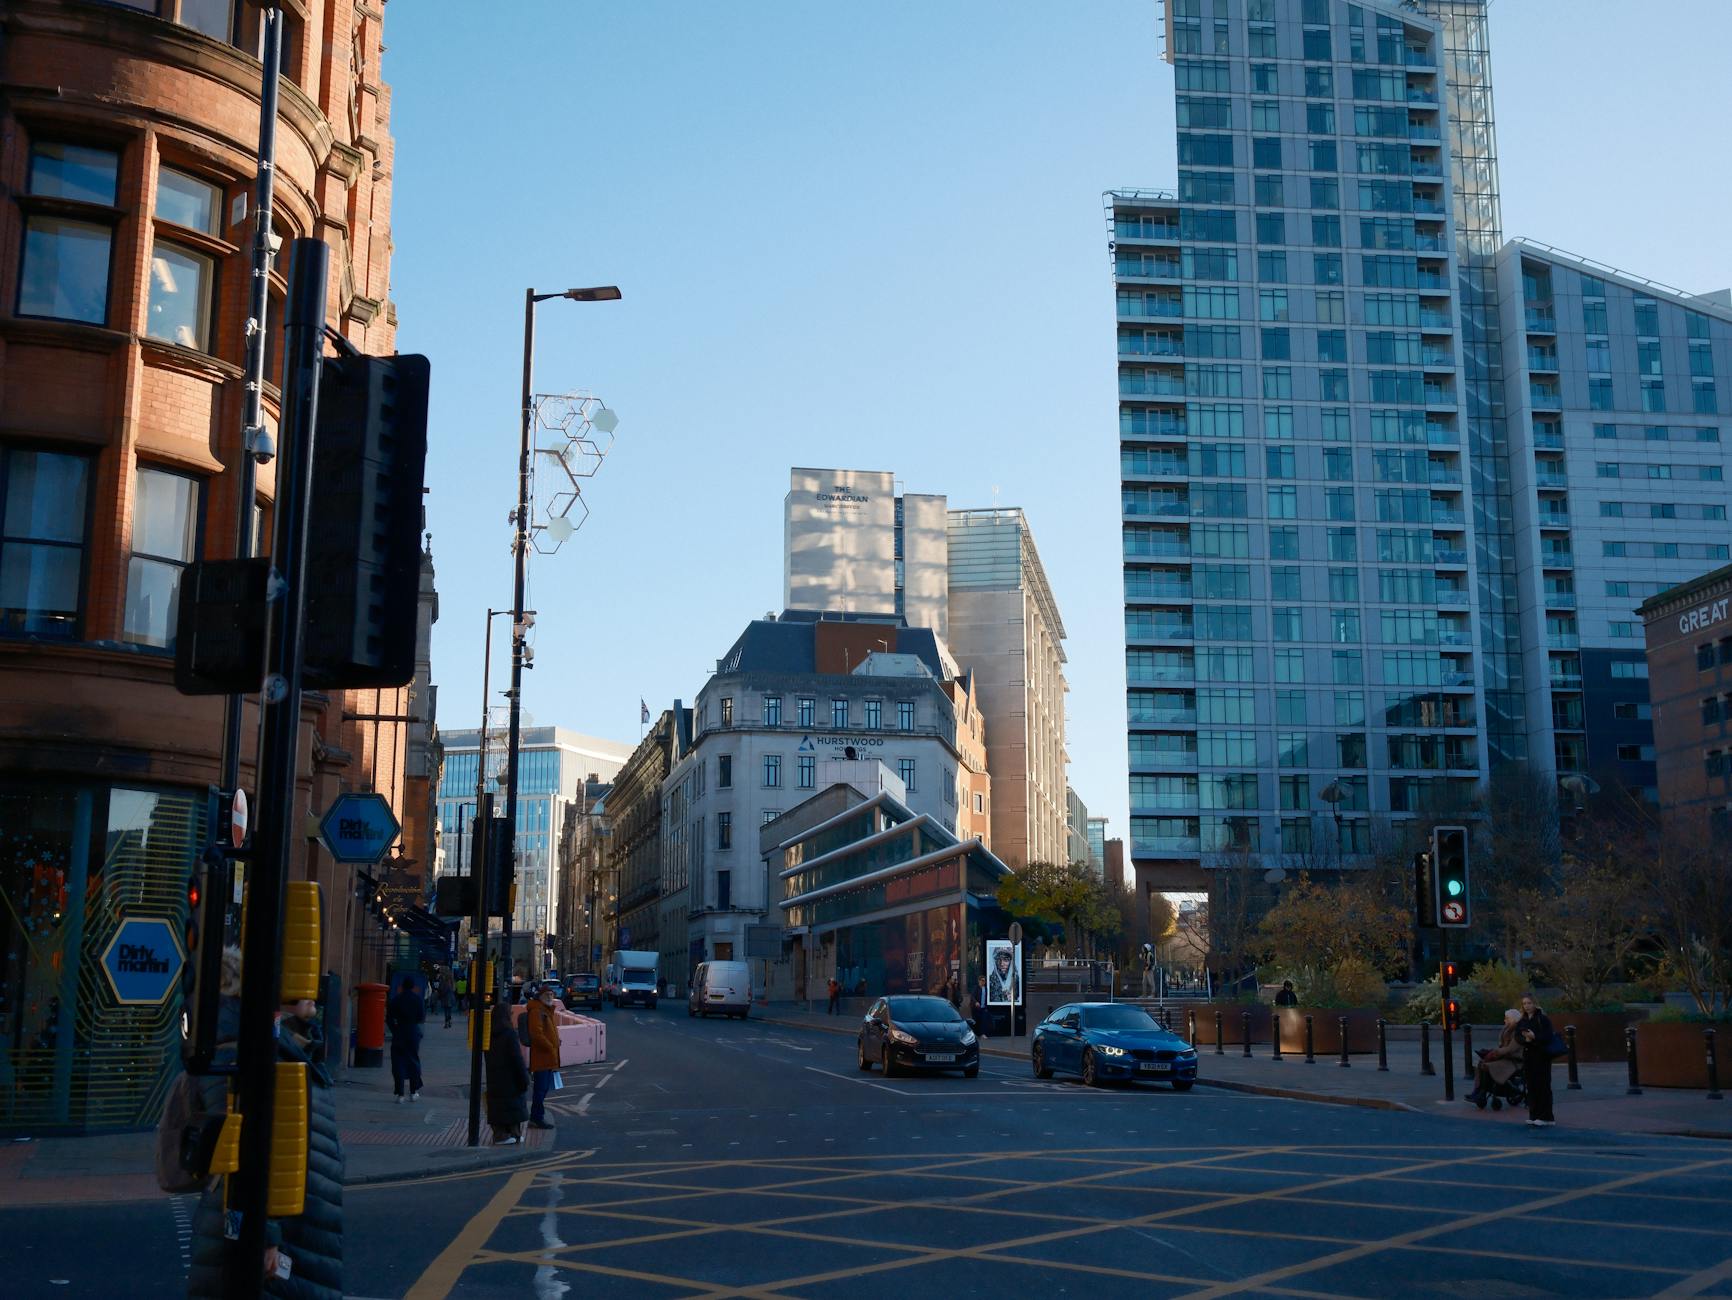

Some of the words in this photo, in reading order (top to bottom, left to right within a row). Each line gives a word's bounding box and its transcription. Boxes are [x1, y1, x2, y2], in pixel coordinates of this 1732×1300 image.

[816, 494, 869, 502] EDWARDIAN
[1679, 599, 1729, 634] GREAT
[817, 737, 884, 746] HURSTWOOD
[339, 818, 369, 832] Dirty
[119, 944, 154, 962] Dirty
[118, 958, 169, 973] martini
